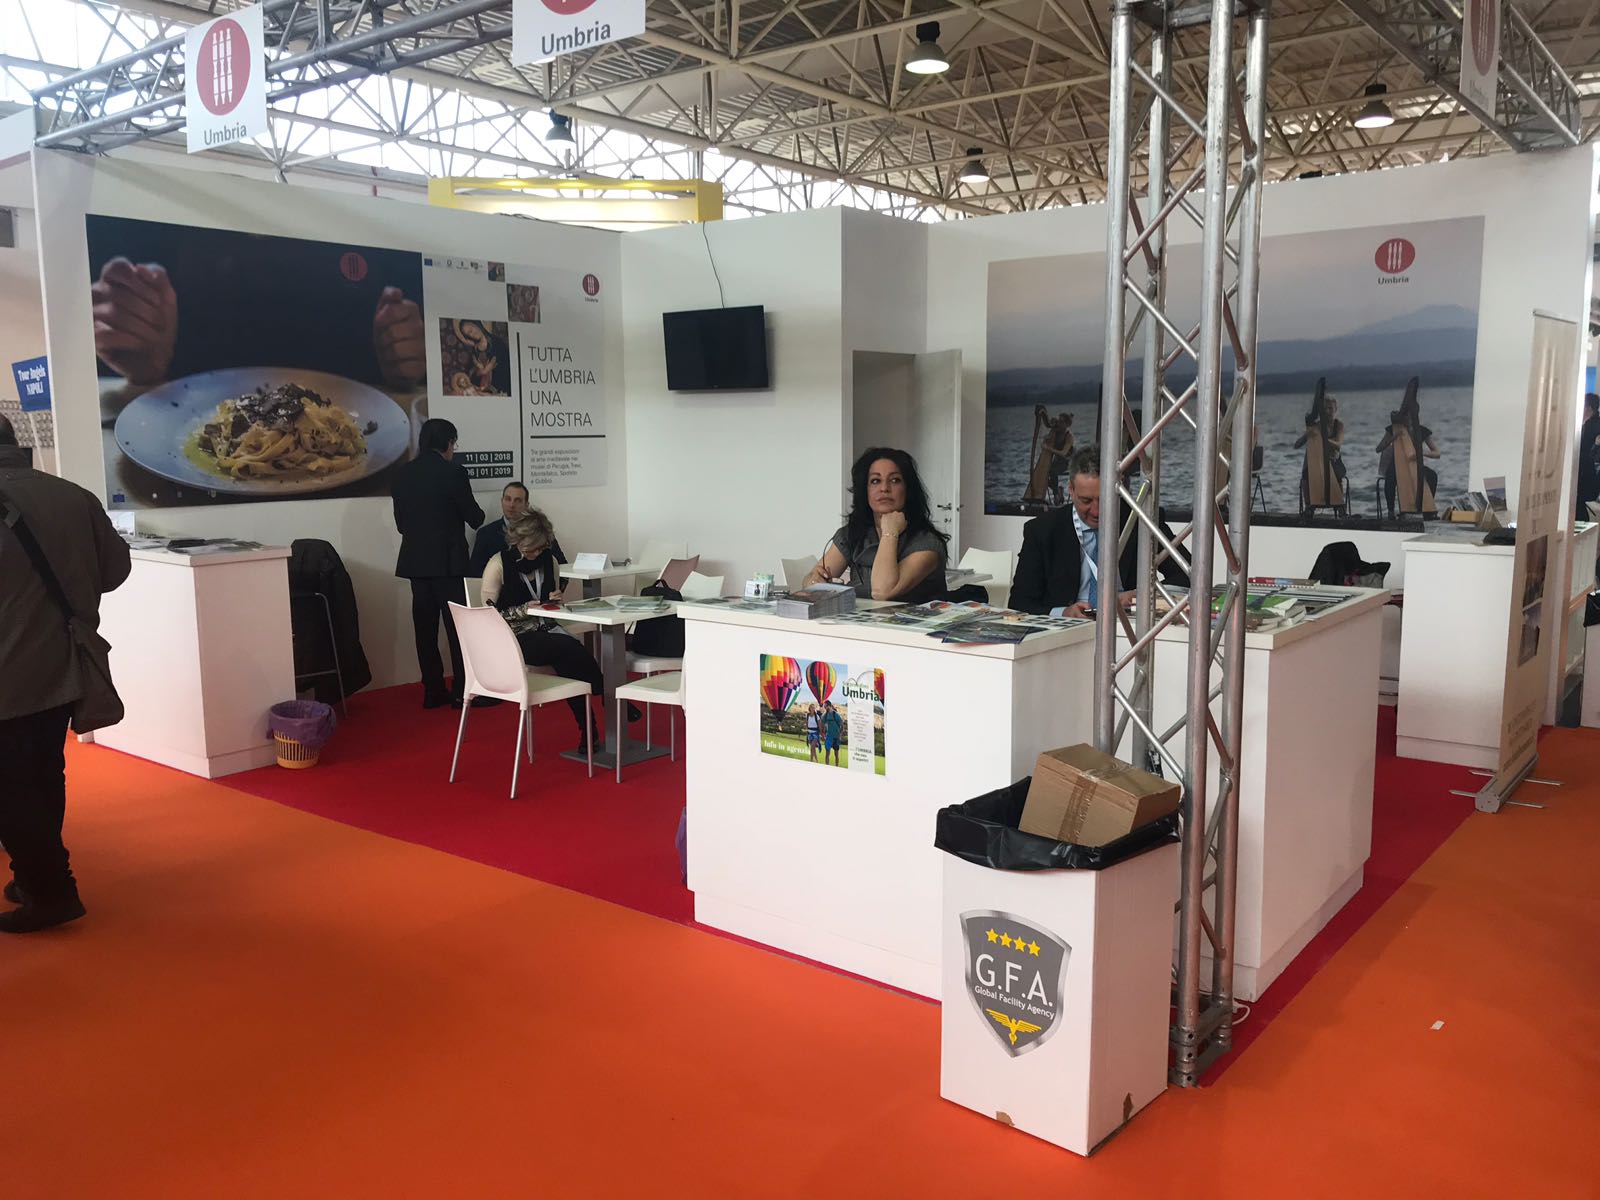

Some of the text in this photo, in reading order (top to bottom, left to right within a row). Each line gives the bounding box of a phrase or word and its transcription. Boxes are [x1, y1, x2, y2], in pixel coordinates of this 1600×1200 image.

[541, 21, 611, 55] Umbria
[204, 122, 247, 145] Umbria
[1377, 276, 1409, 285] Umbria
[528, 346, 572, 362] TUTTA
[529, 368, 596, 384] L'UMBRIA
[530, 390, 562, 405] UNA
[530, 412, 592, 428] MOSTRA
[480, 453, 488, 461] 03
[494, 453, 511, 461] 2018
[494, 467, 511, 475] 2019
[842, 686, 880, 702] Umbria
[975, 953, 1053, 1007] G.F.A.
[974, 985, 1055, 1020] Global Facility Agency
